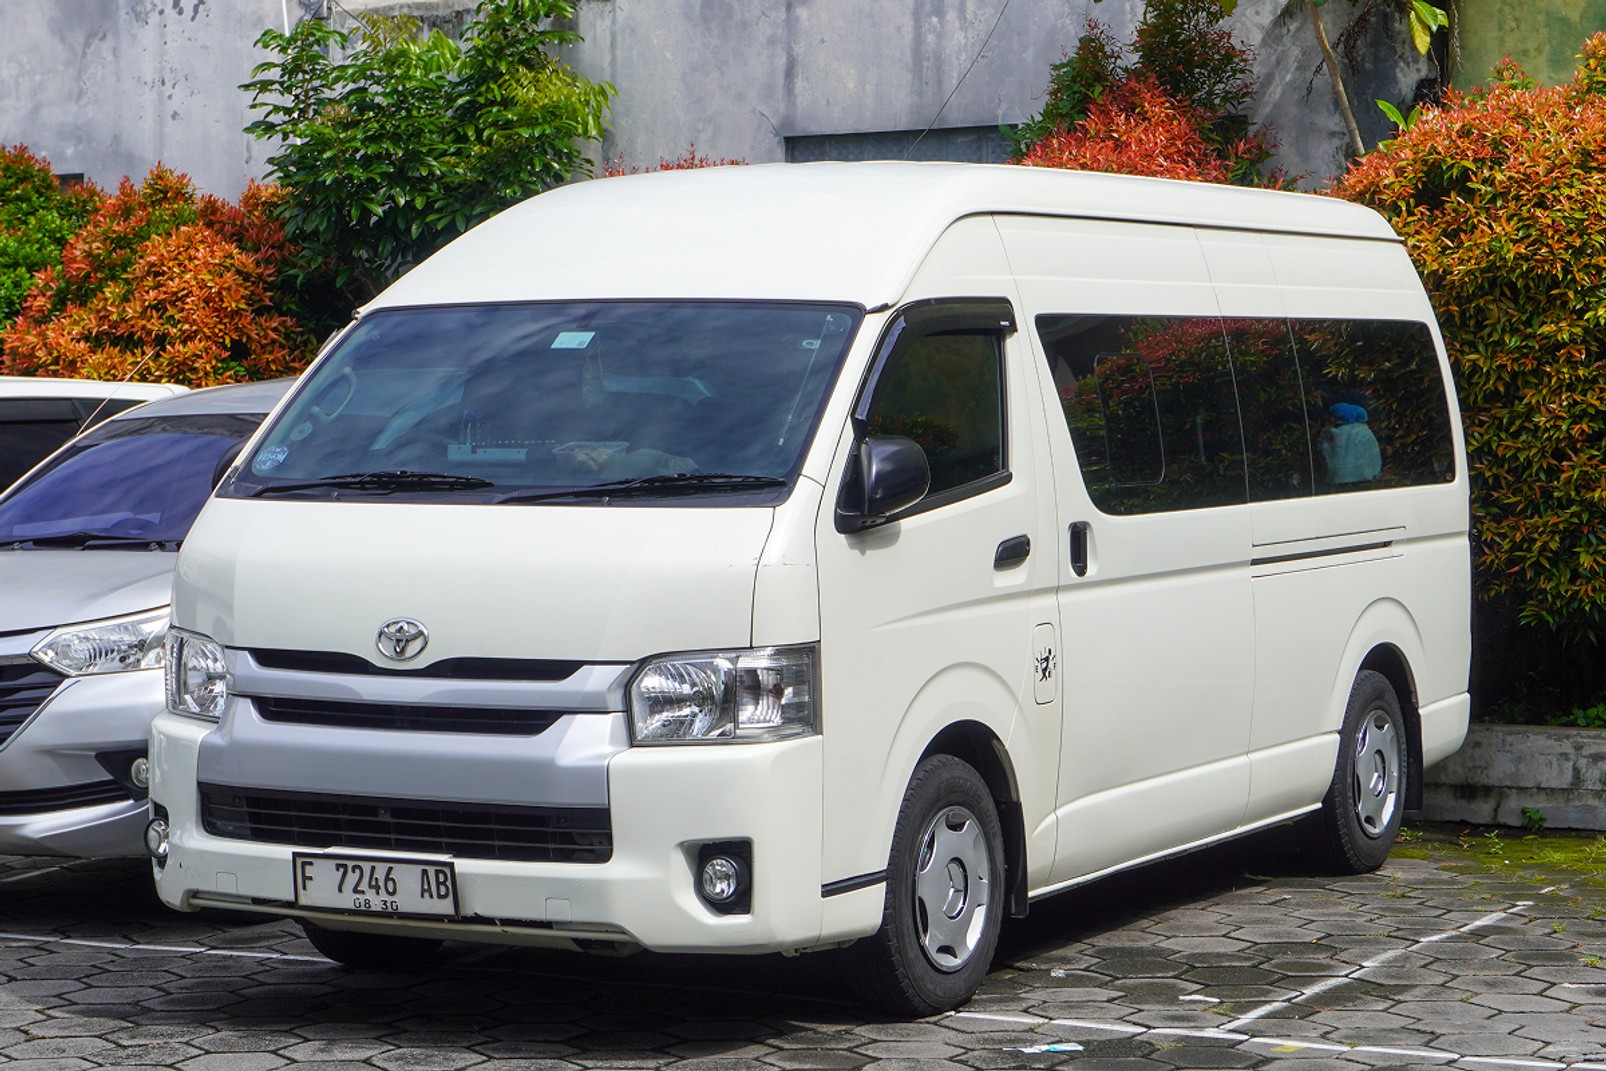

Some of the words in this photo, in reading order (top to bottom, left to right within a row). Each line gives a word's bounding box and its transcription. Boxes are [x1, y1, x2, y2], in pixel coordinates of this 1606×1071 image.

[301, 861, 314, 891] F
[335, 863, 397, 896] 7246
[420, 868, 450, 899] AB
